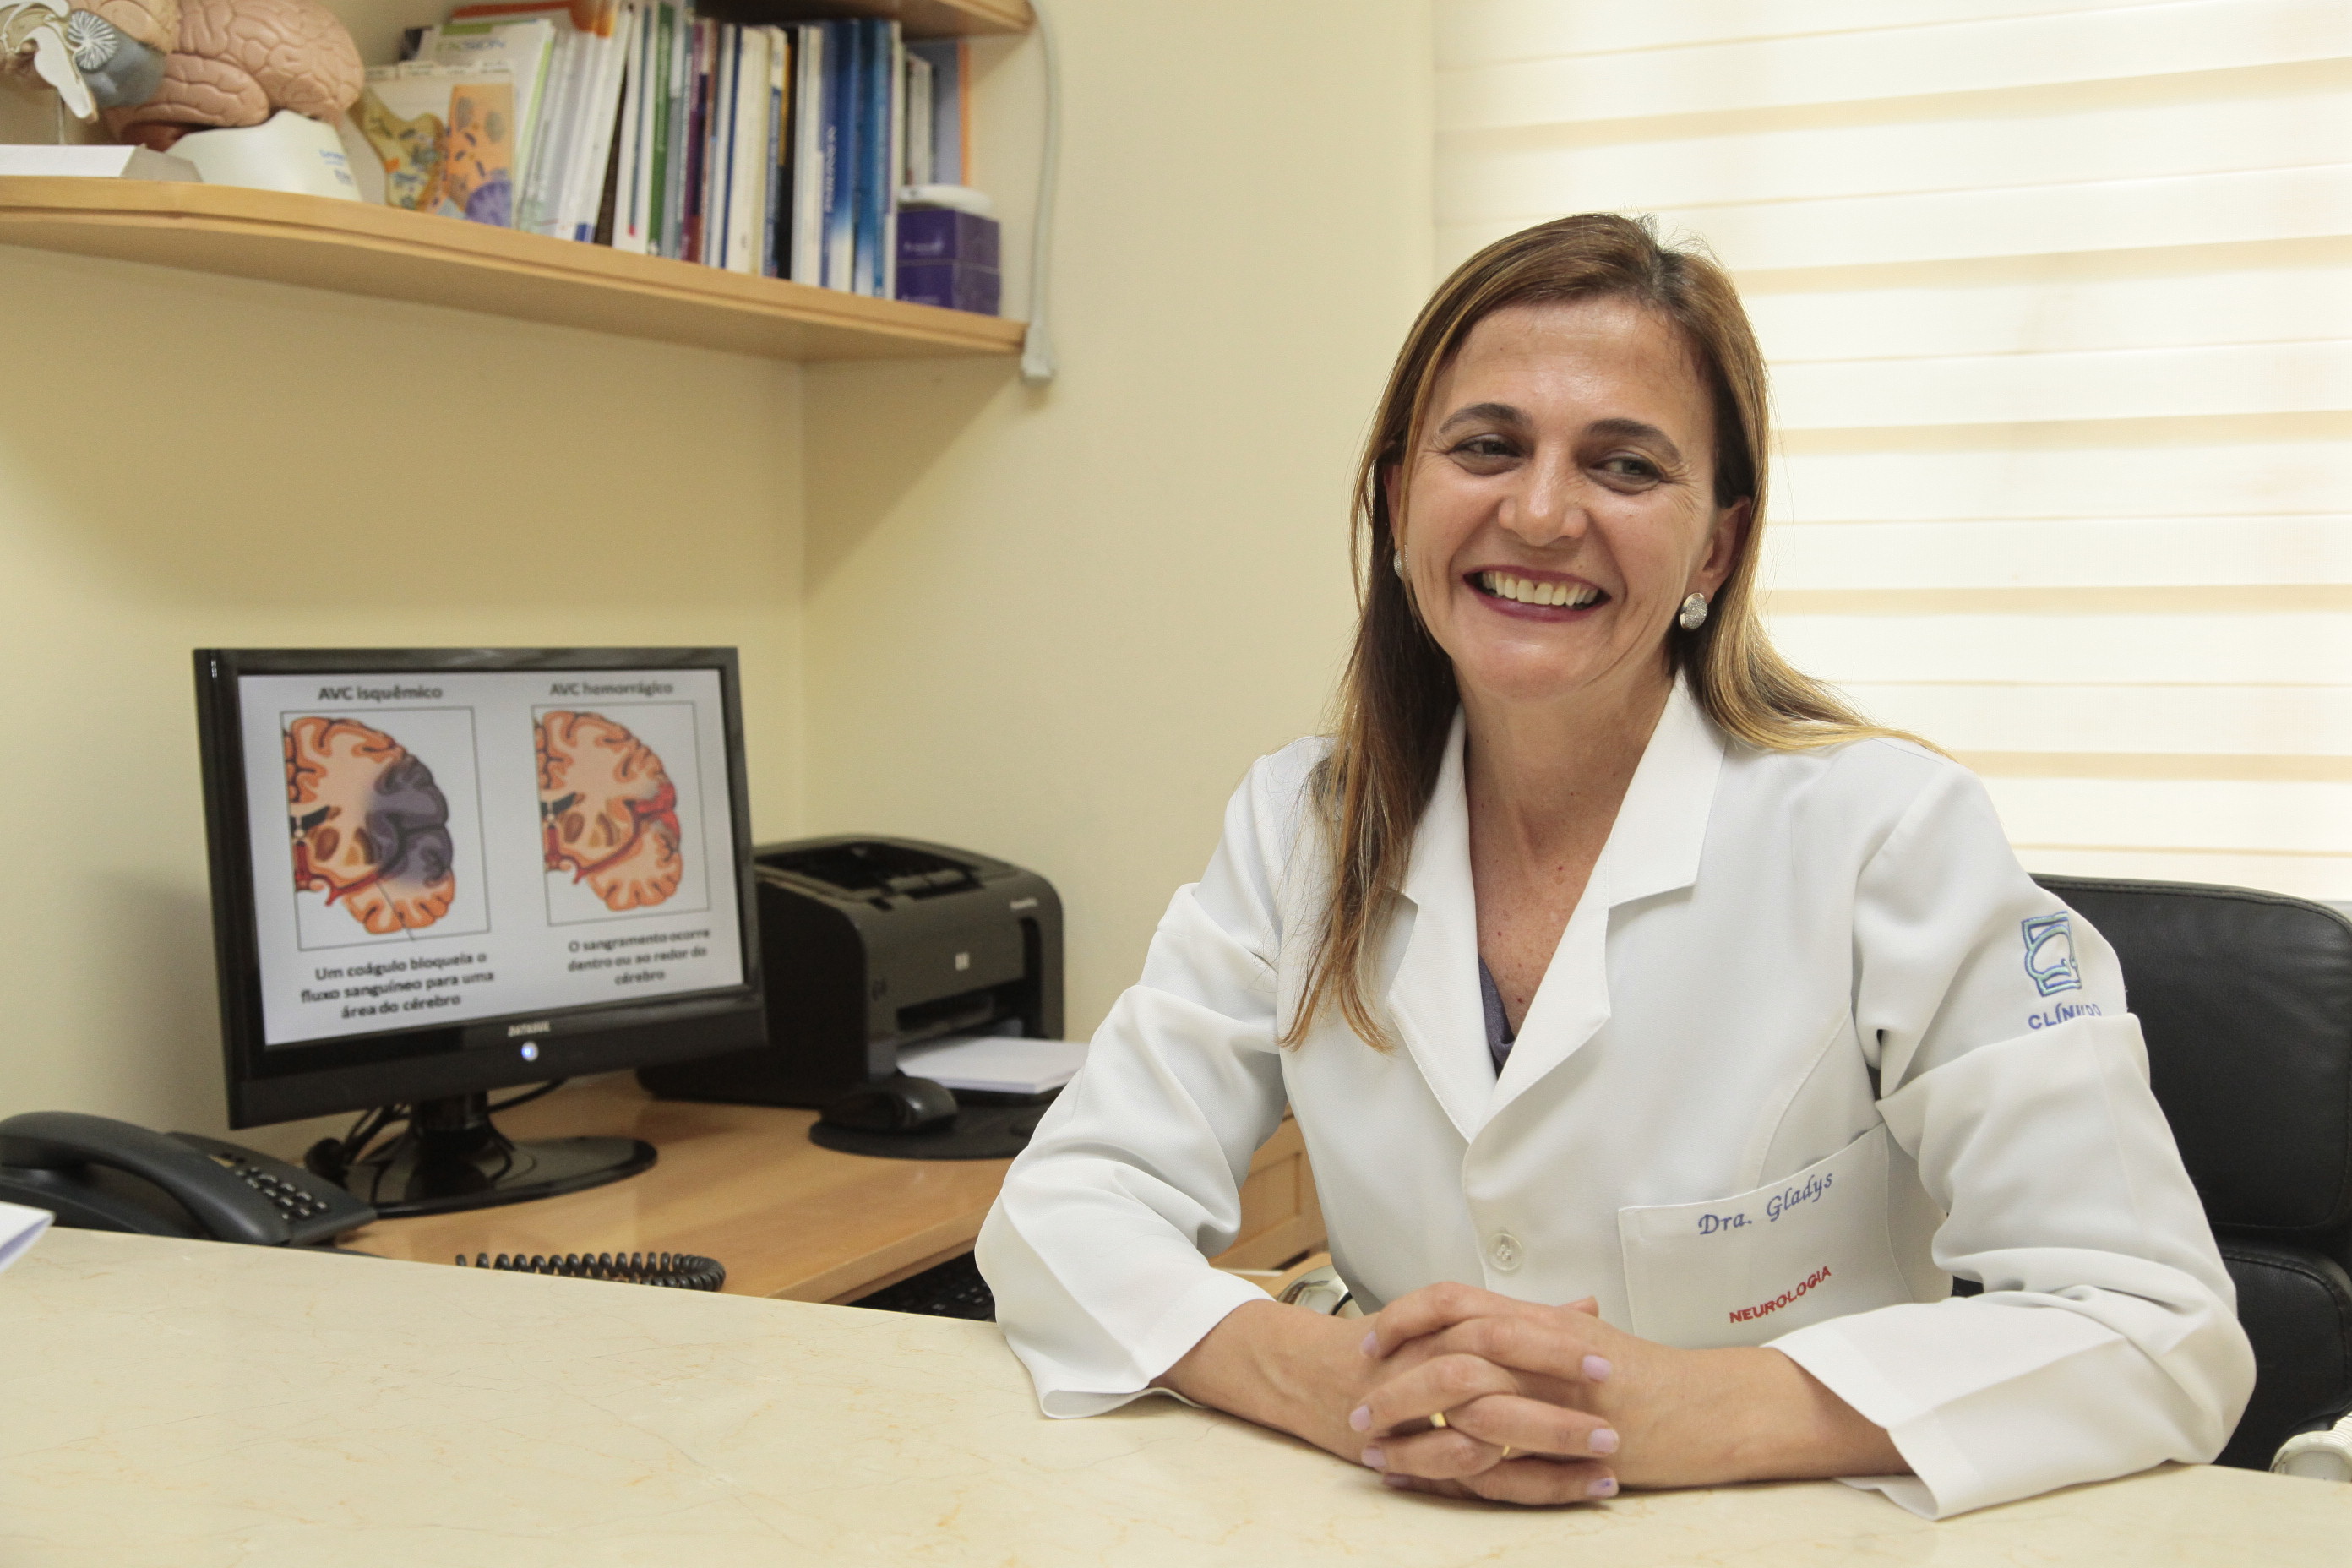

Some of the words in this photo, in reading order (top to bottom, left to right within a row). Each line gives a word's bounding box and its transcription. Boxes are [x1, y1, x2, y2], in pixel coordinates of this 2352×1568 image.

[318, 685, 353, 700] AVC
[357, 684, 443, 703] isquêmico
[550, 683, 580, 696] AVC
[582, 681, 674, 697] hemorrágico
[568, 940, 580, 953] O
[583, 934, 667, 951] sangramento
[315, 967, 344, 981] Um
[346, 960, 407, 977] coágulo
[410, 952, 474, 970] bloqueia
[476, 952, 487, 963] o
[568, 957, 612, 972] dentro
[614, 956, 631, 966] ou
[635, 955, 651, 964] ao
[690, 946, 707, 957] do
[301, 988, 340, 1004] fluxo
[344, 979, 422, 998] sanguíneo
[426, 977, 459, 990] para
[462, 971, 494, 984] uma
[614, 971, 666, 986] cérebro
[341, 1005, 377, 1019] área
[378, 1000, 400, 1014] do
[401, 994, 461, 1012] cérebro
[1697, 1213, 1753, 1236] Dra.
[1766, 1173, 1833, 1222] Gladys
[1729, 1266, 1832, 1324] NEUROLOGIA
